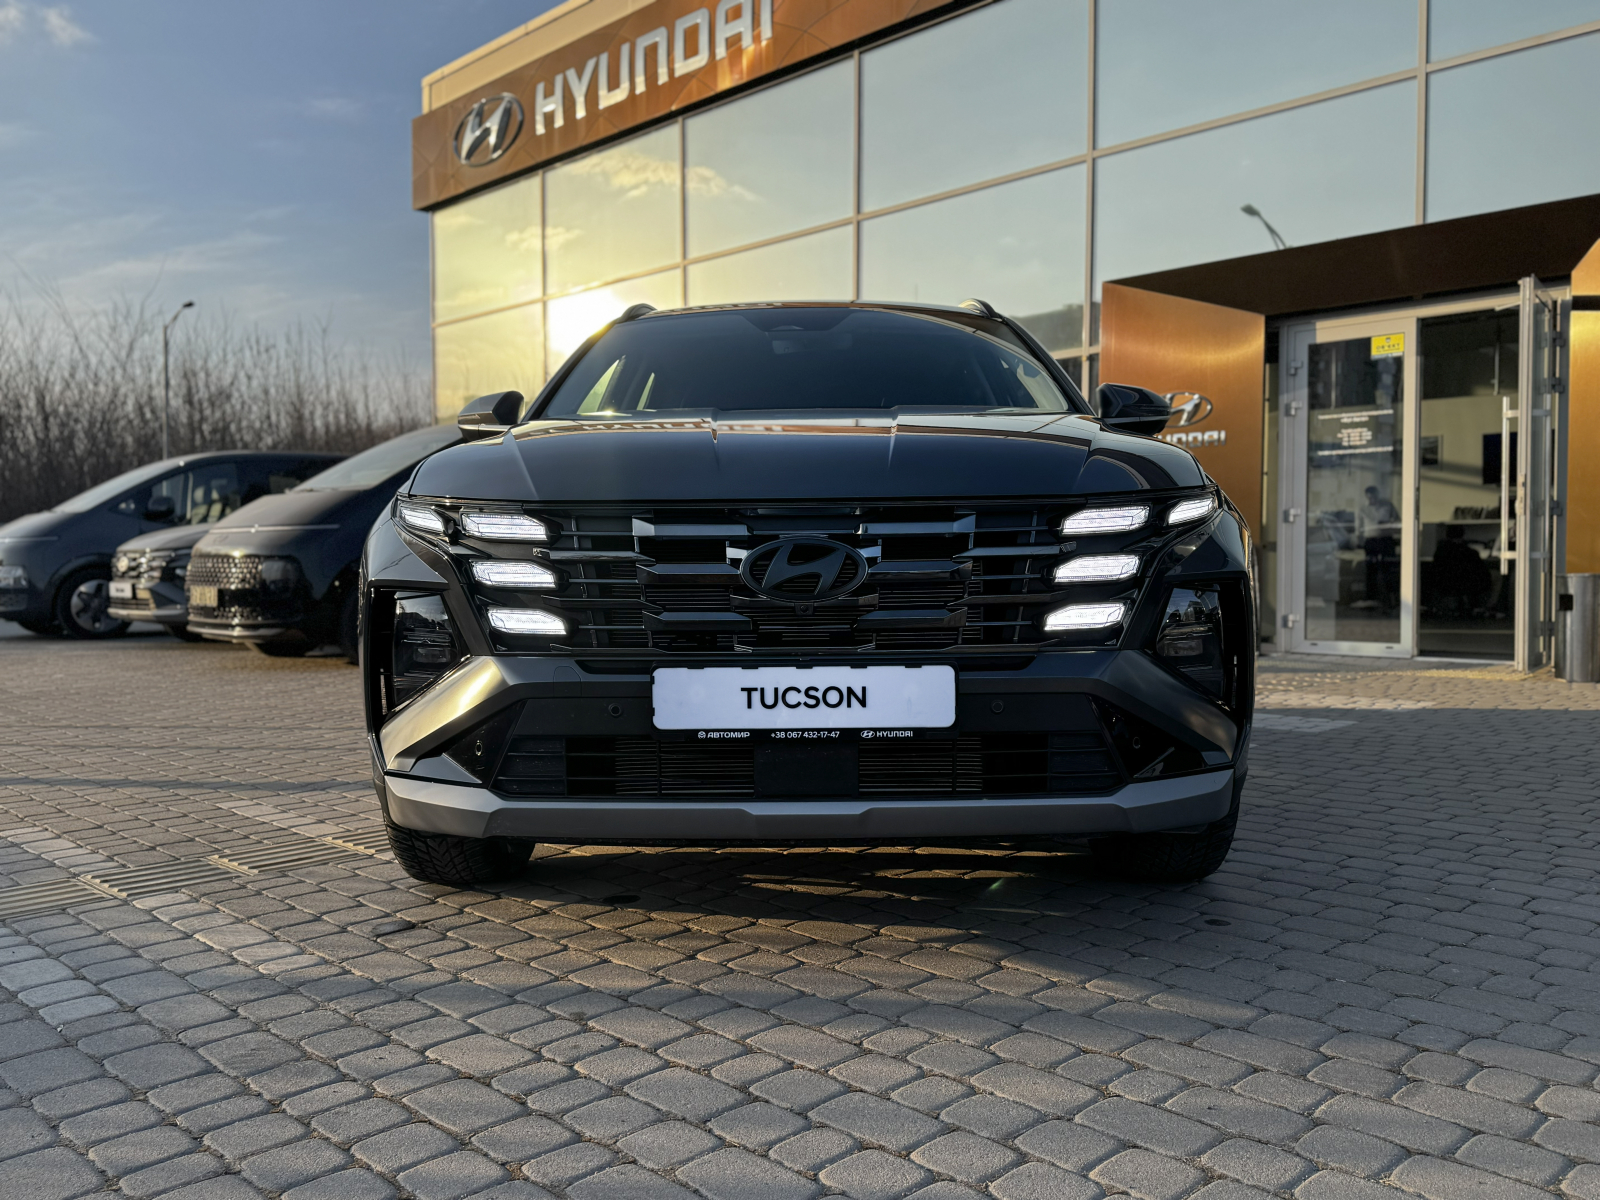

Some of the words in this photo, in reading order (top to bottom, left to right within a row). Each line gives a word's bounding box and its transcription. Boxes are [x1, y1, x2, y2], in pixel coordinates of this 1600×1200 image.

[534, 0, 773, 136] HYUNDAI
[740, 686, 867, 710] TUCSON
[707, 731, 750, 739] АВТОМИР
[771, 731, 786, 739] +38
[787, 731, 802, 739] 067
[803, 731, 840, 739] 432-17-47
[876, 730, 914, 738] HYUNDAI
